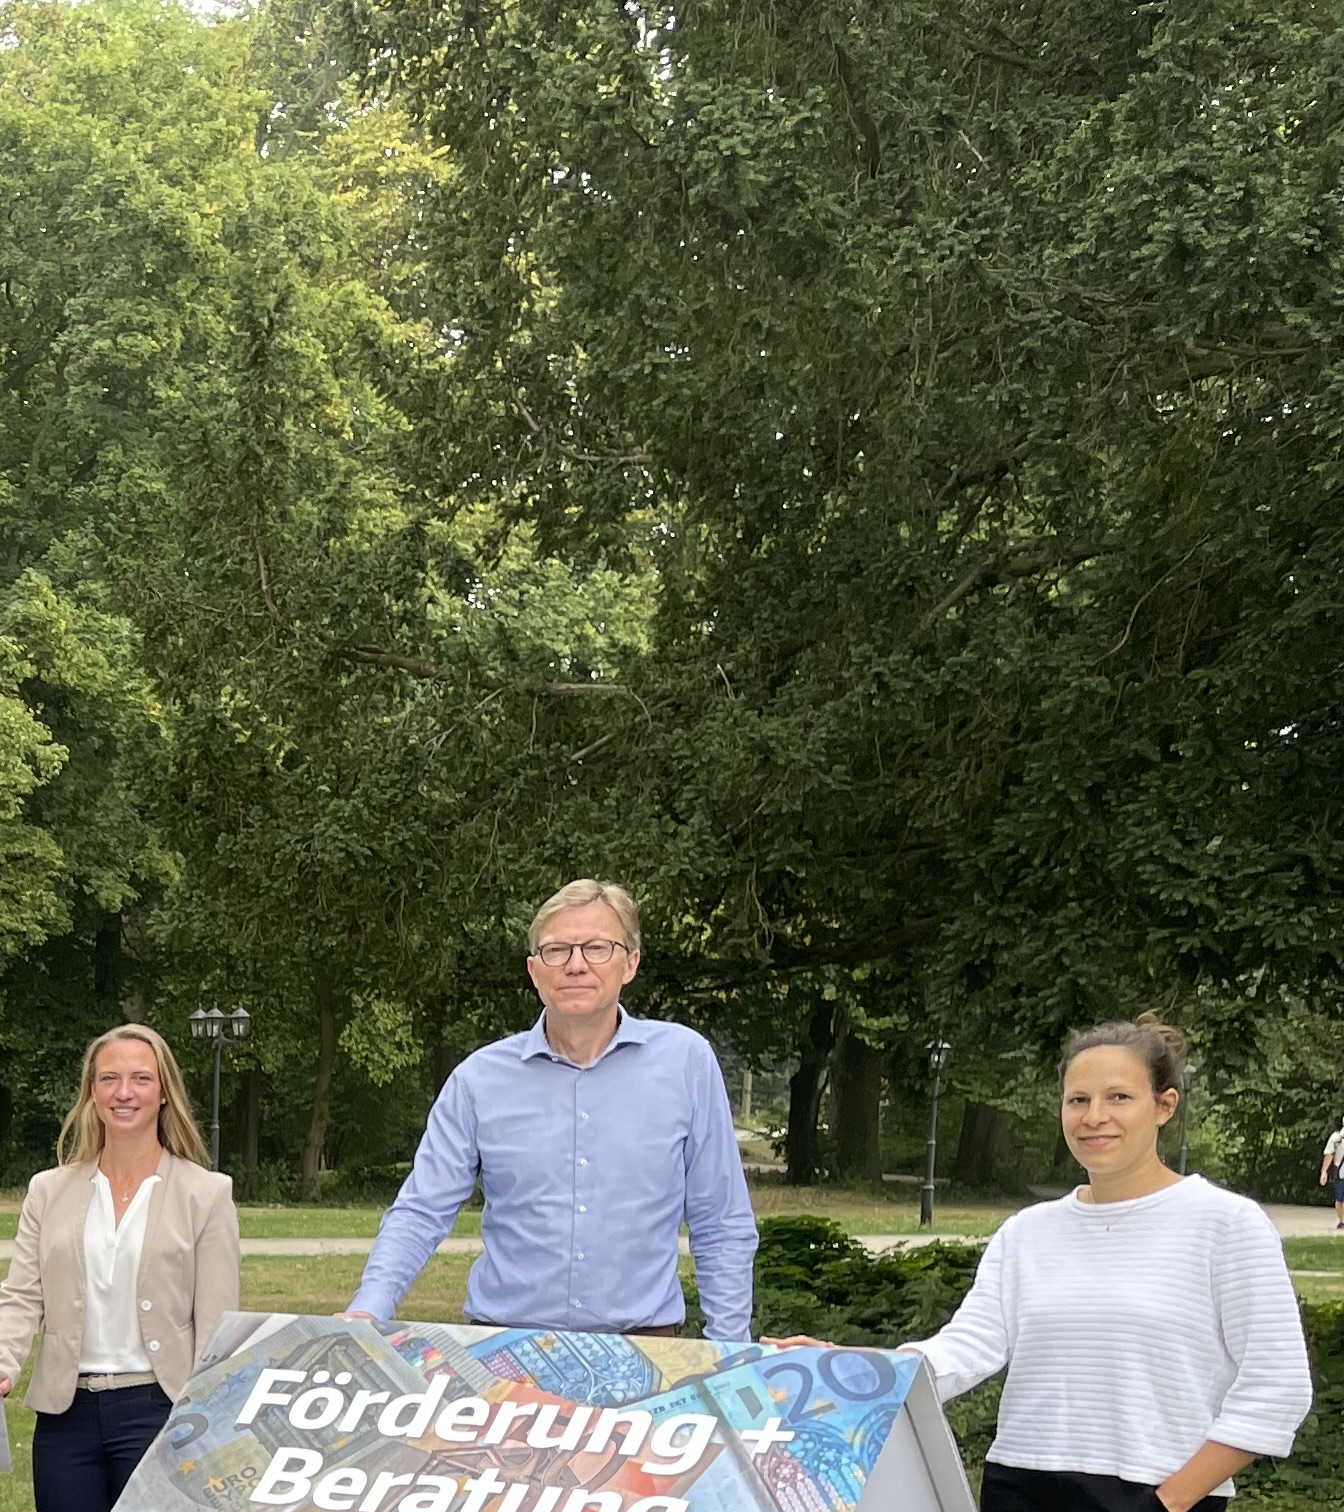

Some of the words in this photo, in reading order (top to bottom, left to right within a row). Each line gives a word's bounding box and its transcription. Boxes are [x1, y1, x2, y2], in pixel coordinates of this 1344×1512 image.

[235, 1369, 717, 1476] Förderung
[740, 1417, 795, 1456] +
[764, 1350, 897, 1425] 20
